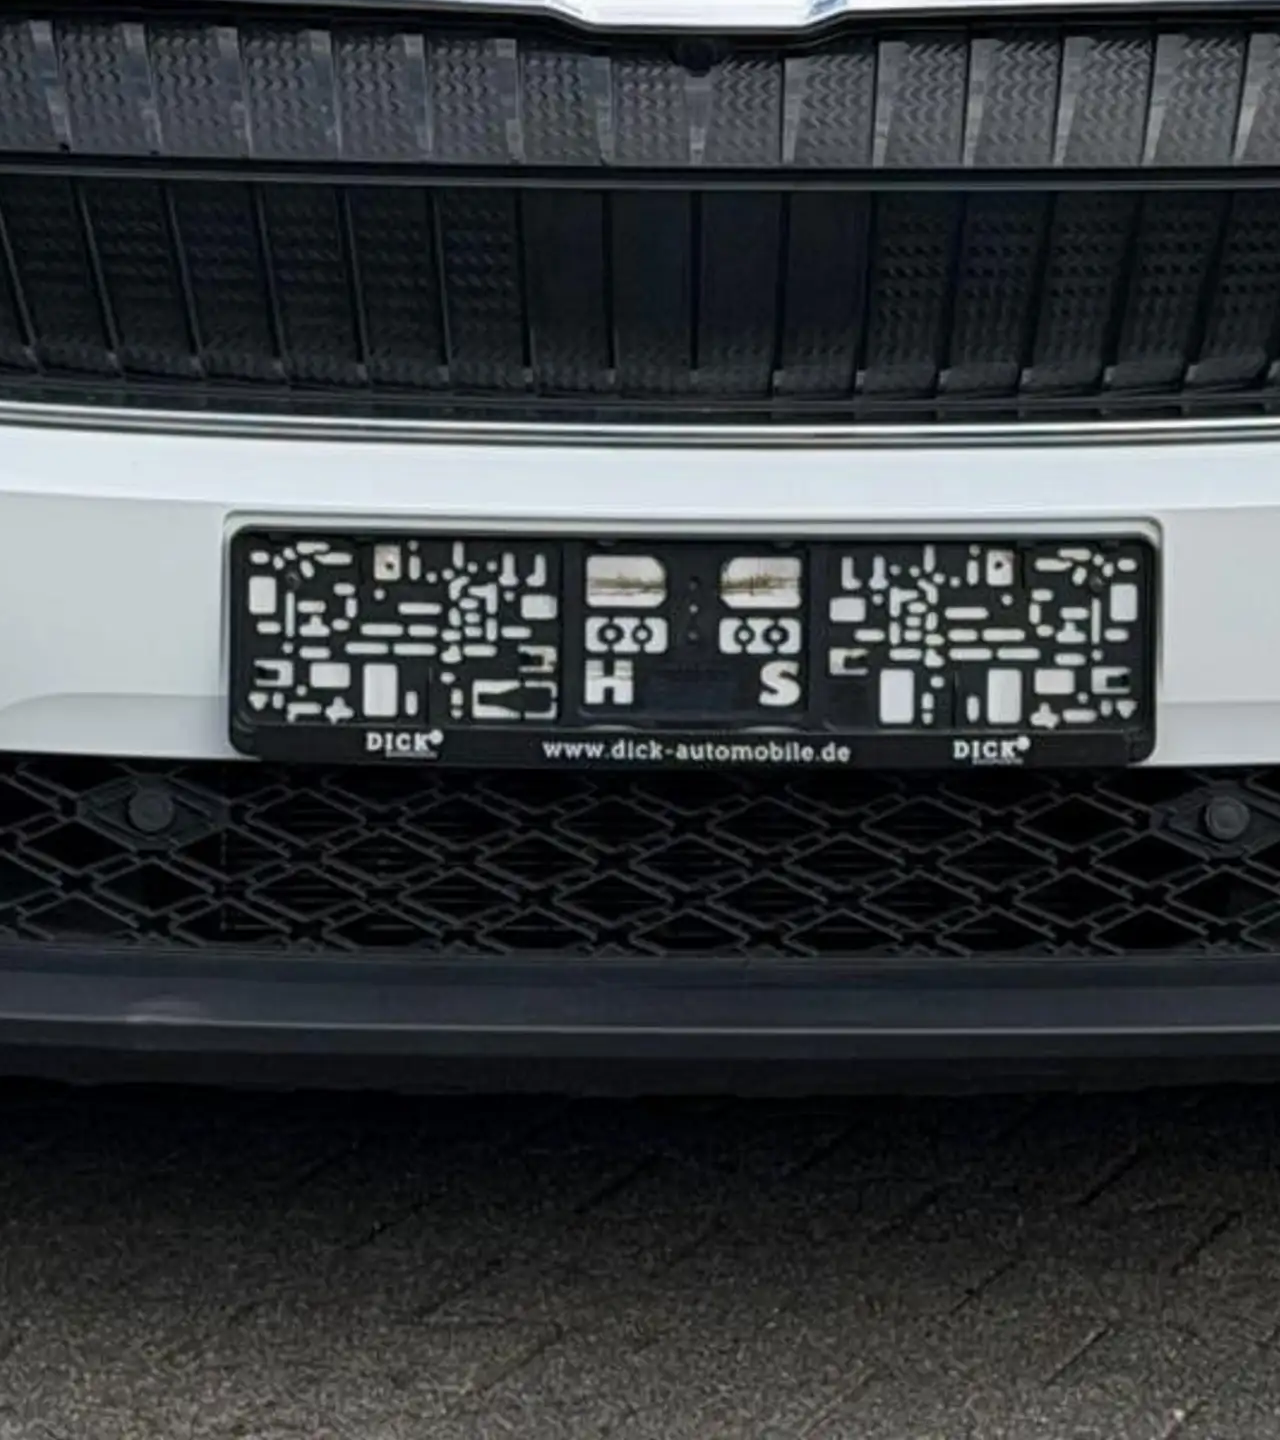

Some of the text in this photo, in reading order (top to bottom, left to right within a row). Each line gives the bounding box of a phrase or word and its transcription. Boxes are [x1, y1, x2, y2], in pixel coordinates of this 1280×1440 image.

[758, 660, 802, 707] S
[366, 731, 431, 752] DICK
[542, 739, 851, 762] www.dick-automobile.de
[953, 740, 1018, 760] DICK
